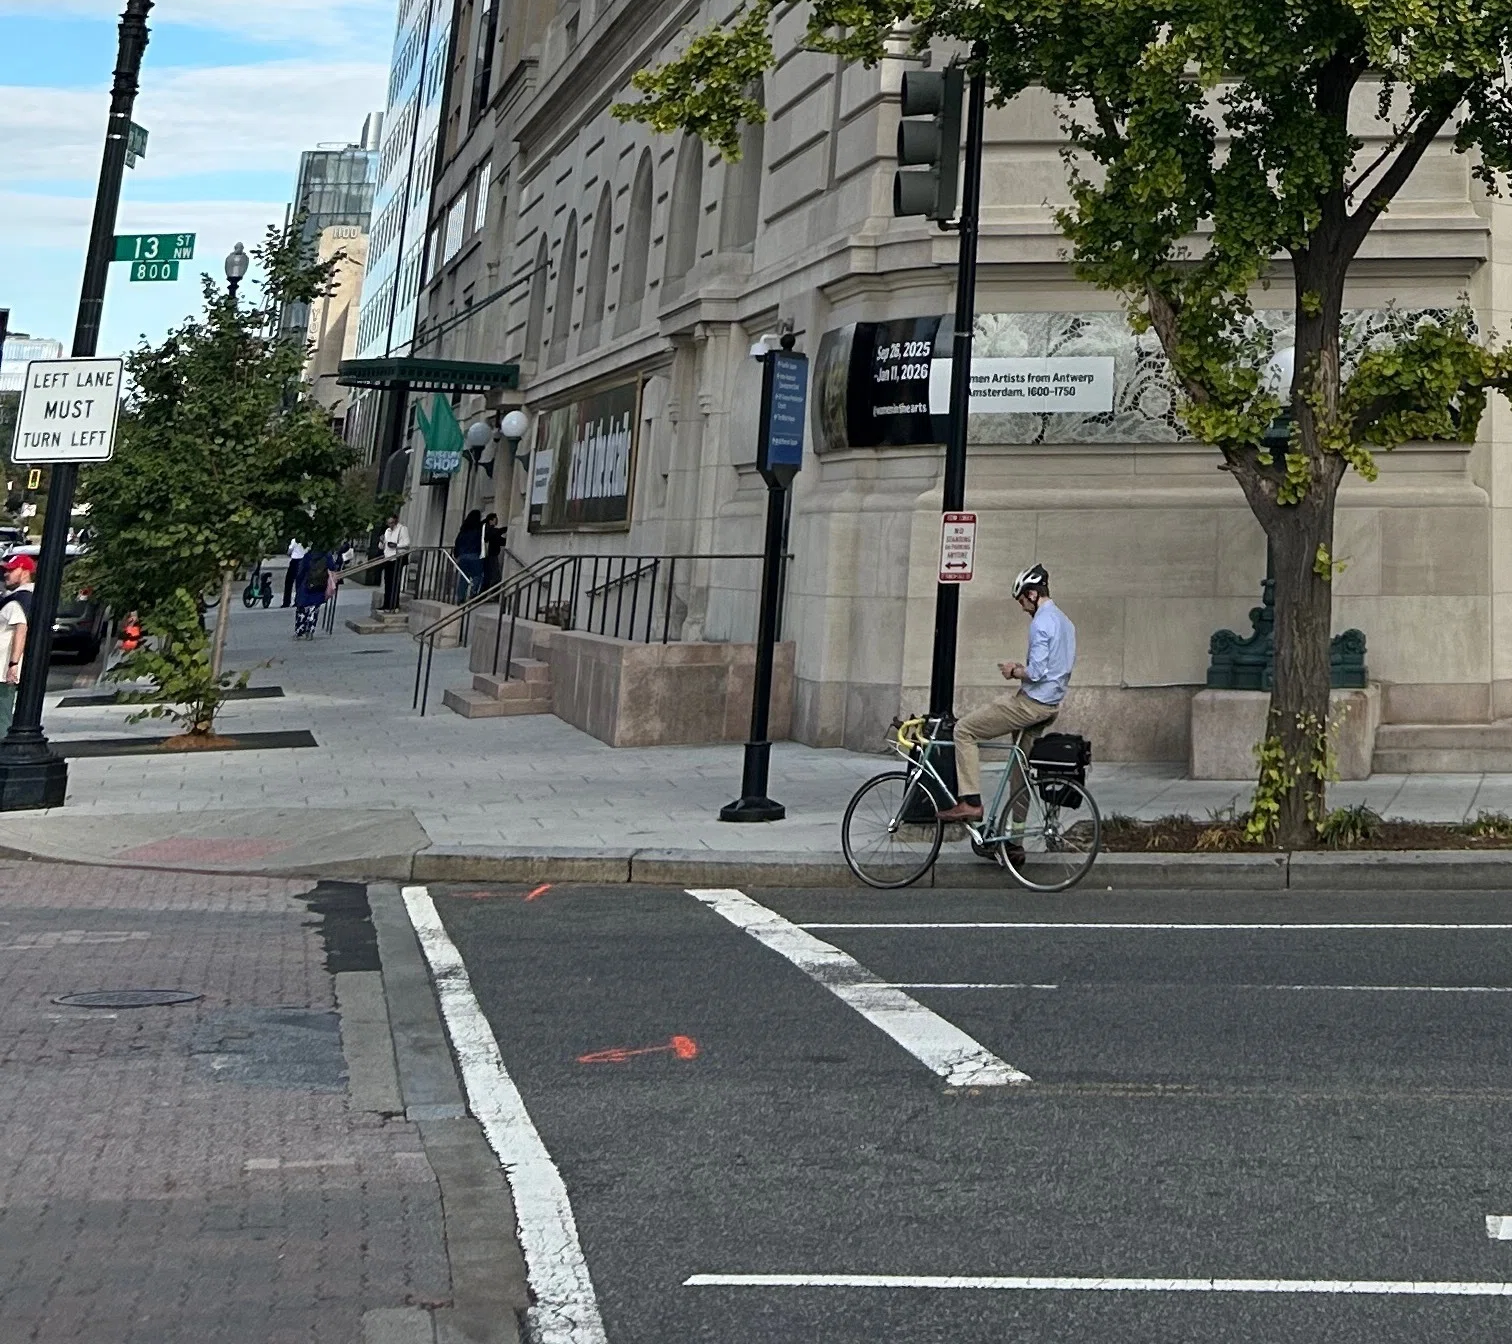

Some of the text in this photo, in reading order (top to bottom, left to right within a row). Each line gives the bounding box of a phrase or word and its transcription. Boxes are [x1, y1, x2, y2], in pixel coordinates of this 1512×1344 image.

[134, 235, 192, 259] 13 ST
[173, 247, 192, 258] NW
[137, 264, 171, 279] 800
[902, 341, 931, 358] 2025
[33, 371, 114, 389] LEFT LANE
[900, 363, 929, 380] 2026
[992, 373, 1026, 384] Artists
[1027, 373, 1050, 384] from
[1052, 372, 1094, 385] Antwerp
[43, 399, 95, 419] MUST
[24, 430, 107, 448] TURN LEFT
[424, 457, 459, 471] SHOP
